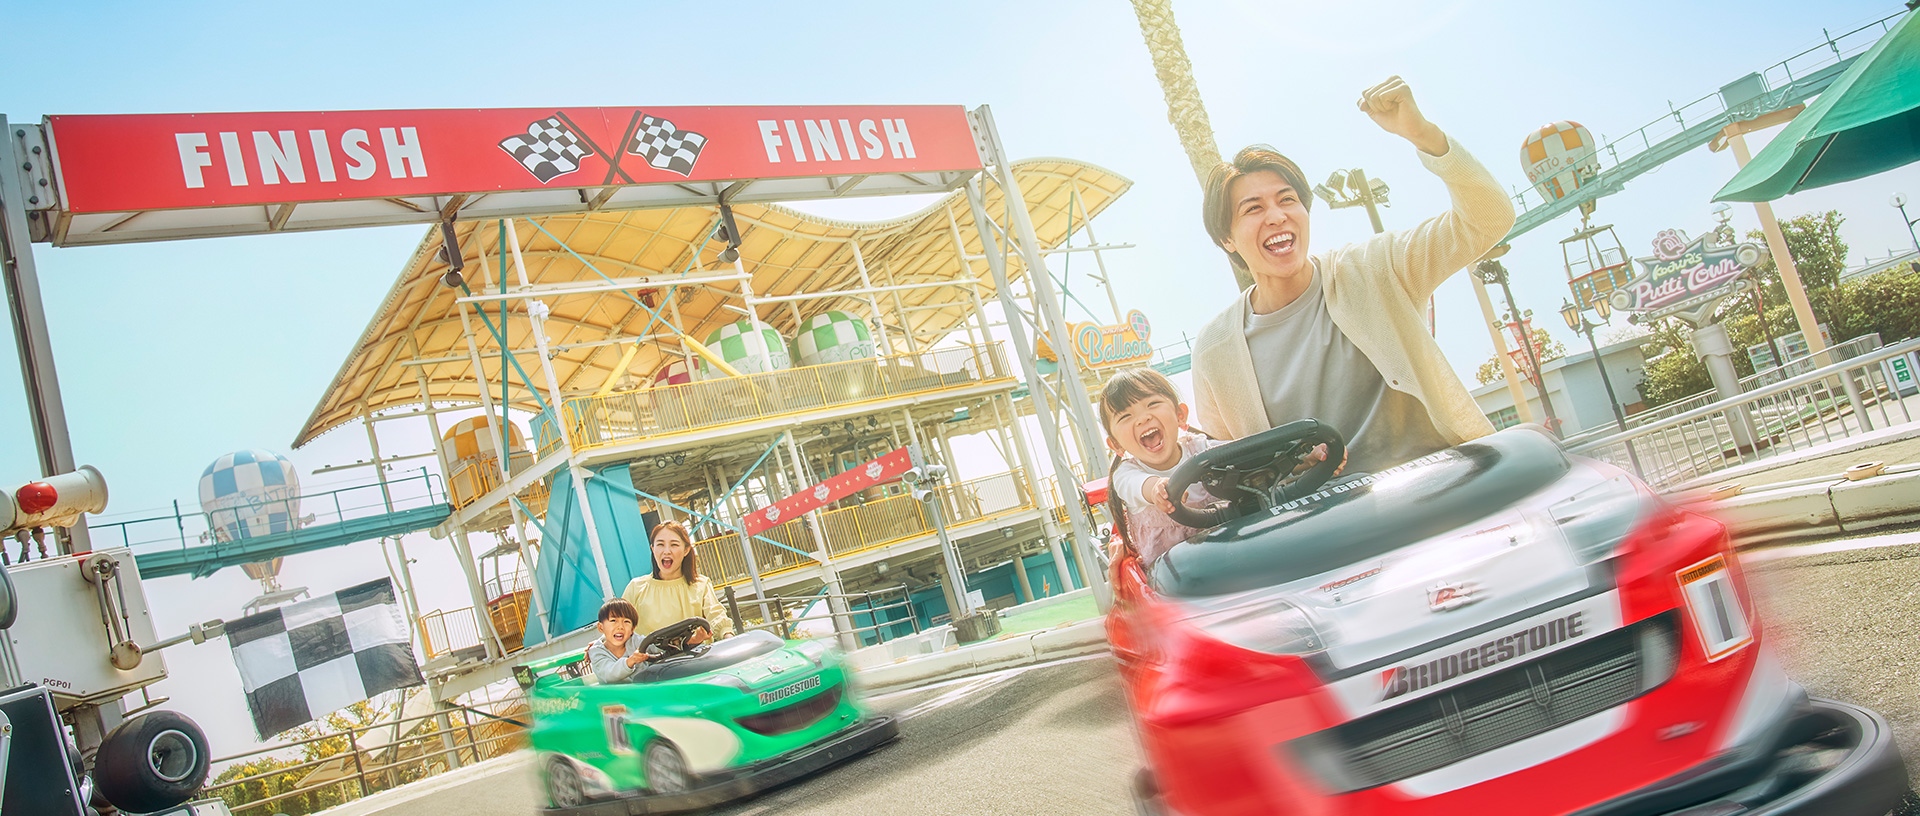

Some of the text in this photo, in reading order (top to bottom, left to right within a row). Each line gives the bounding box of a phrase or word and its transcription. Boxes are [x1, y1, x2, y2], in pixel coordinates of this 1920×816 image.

[174, 126, 428, 189] FINISH
[757, 118, 917, 163] FINISH
[1528, 156, 1560, 183] BATTO
[1631, 258, 1742, 310] Putti Town
[1077, 325, 1152, 363] Balloon
[245, 486, 296, 514] BATTO
[1269, 491, 1331, 516] PUTTI
[1381, 611, 1587, 701] BRIDGESTONE
[43, 677, 72, 690] PGP01
[760, 675, 820, 706] BRIDGESTONE
